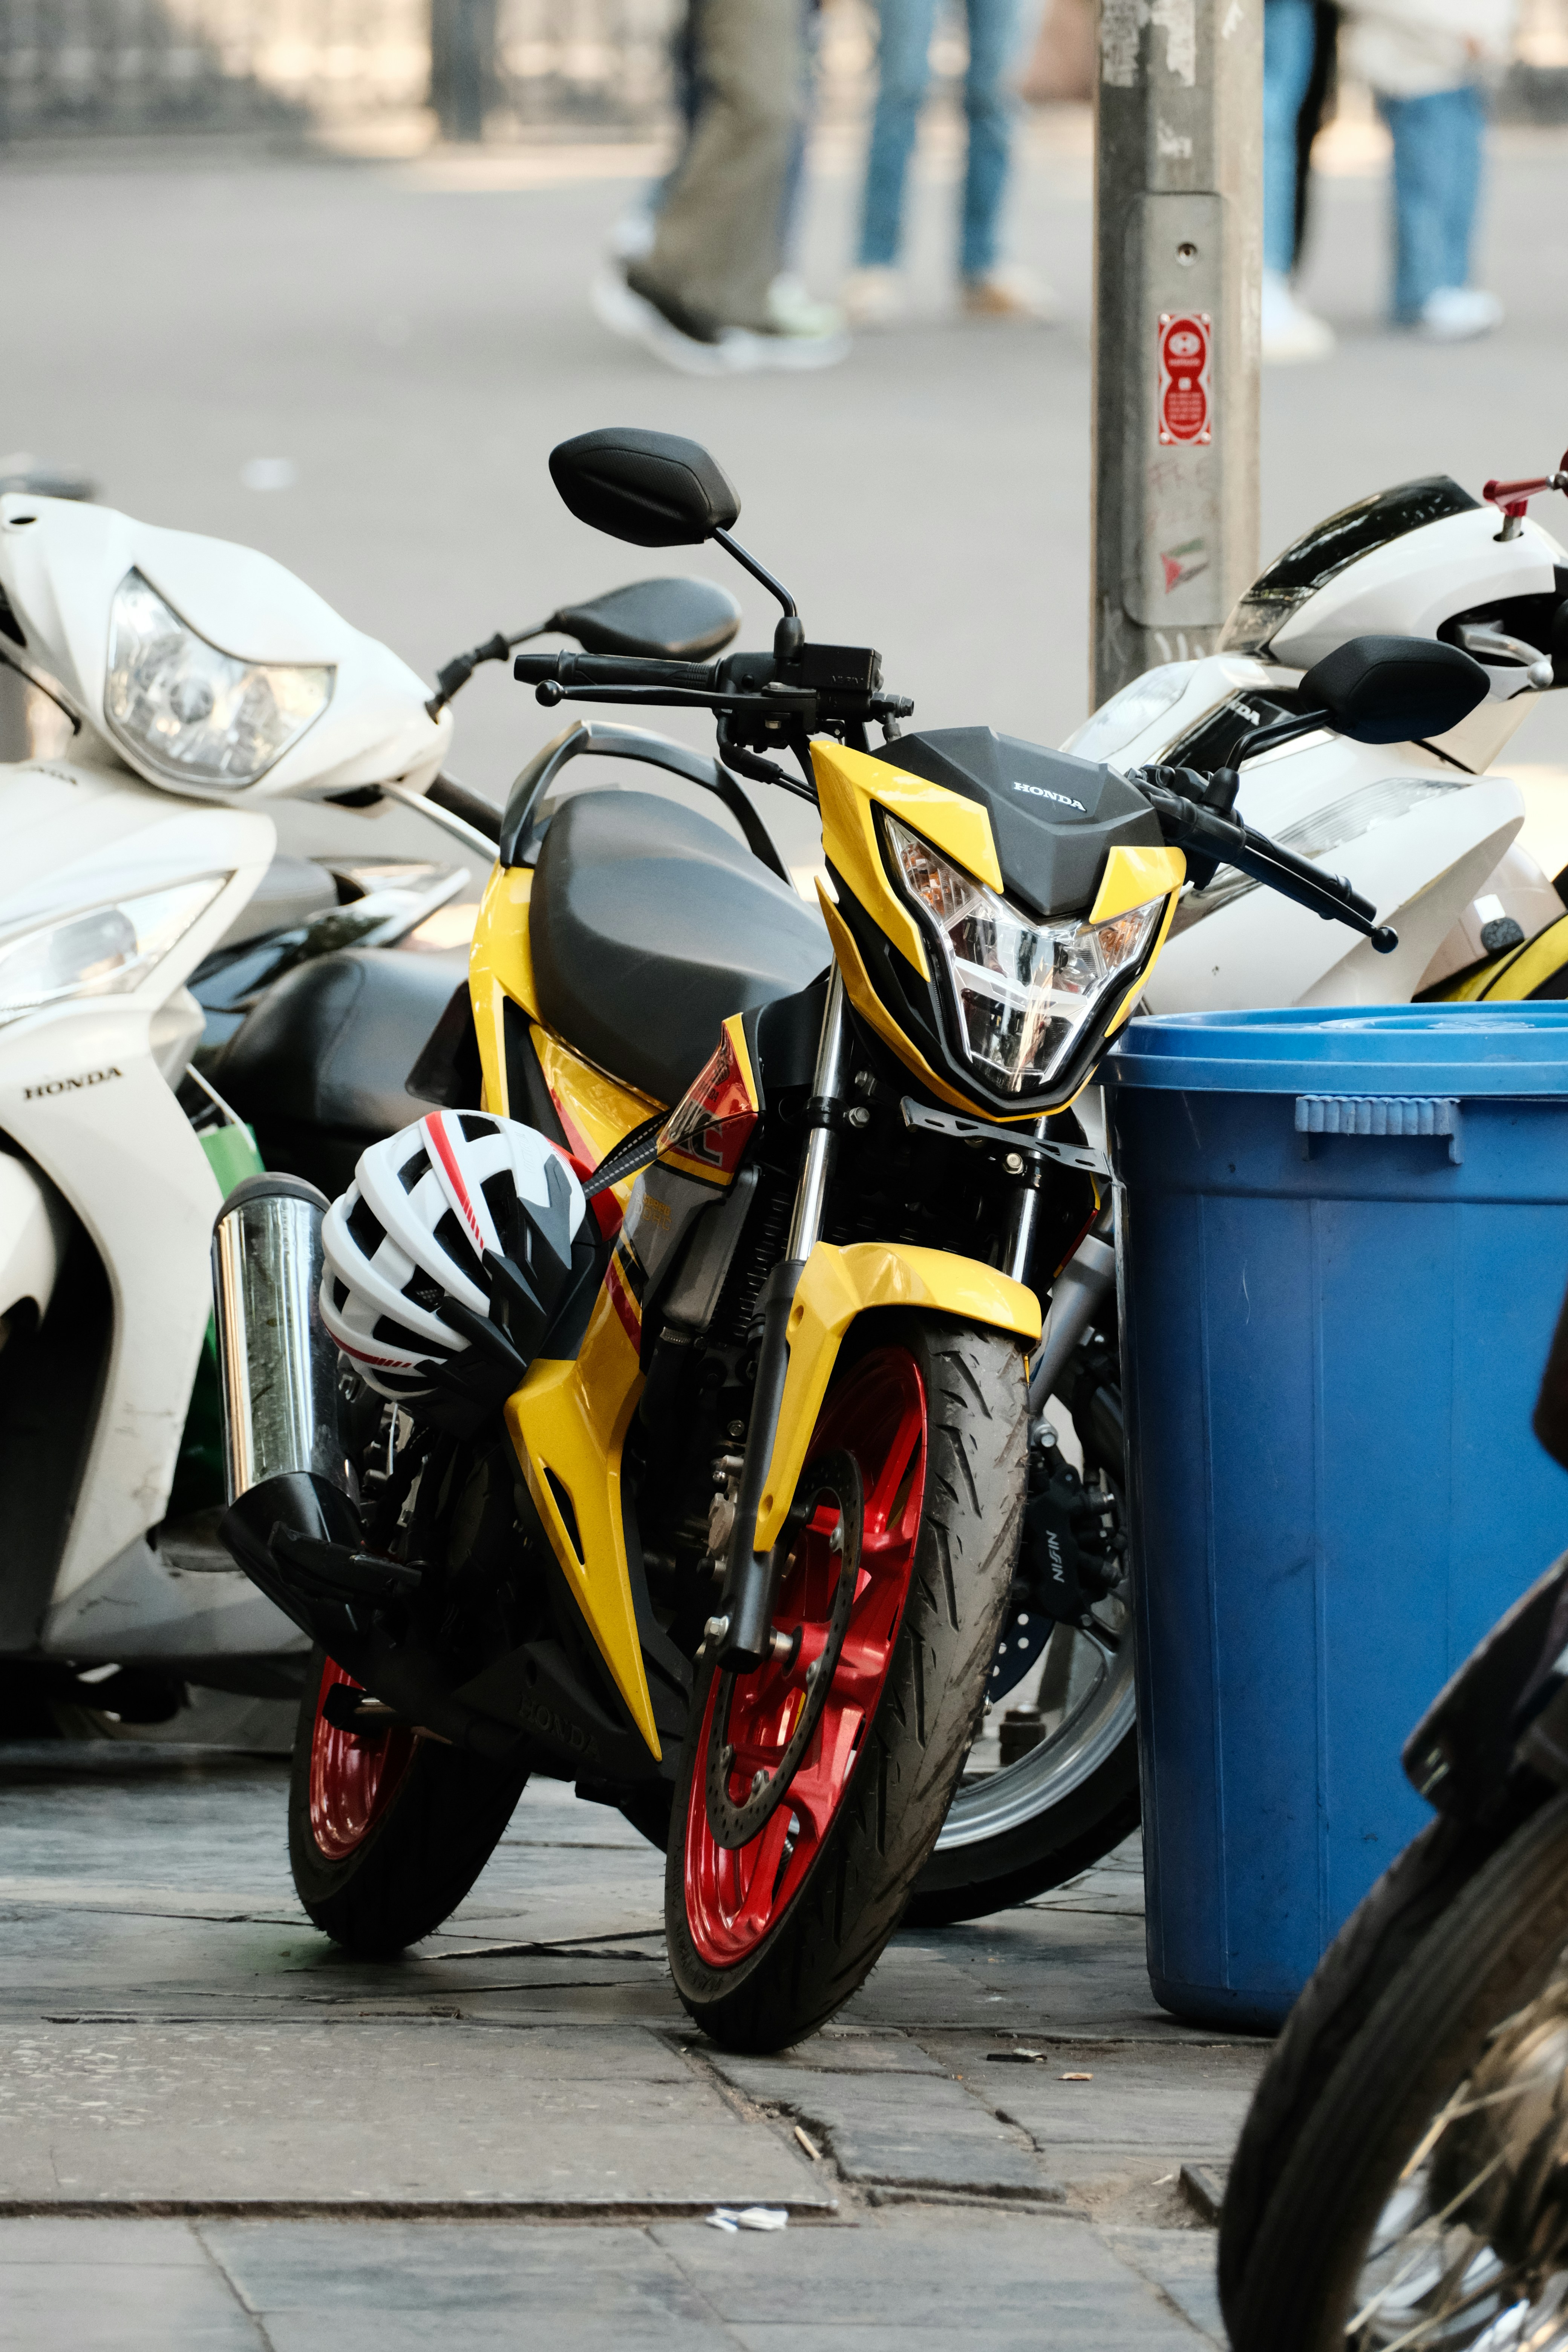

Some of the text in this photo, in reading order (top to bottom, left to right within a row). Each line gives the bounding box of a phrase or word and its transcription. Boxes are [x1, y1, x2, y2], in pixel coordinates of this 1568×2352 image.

[1014, 782, 1087, 812] HONDA
[24, 1066, 122, 1100] HONDA
[519, 1693, 601, 1763] HONDA
